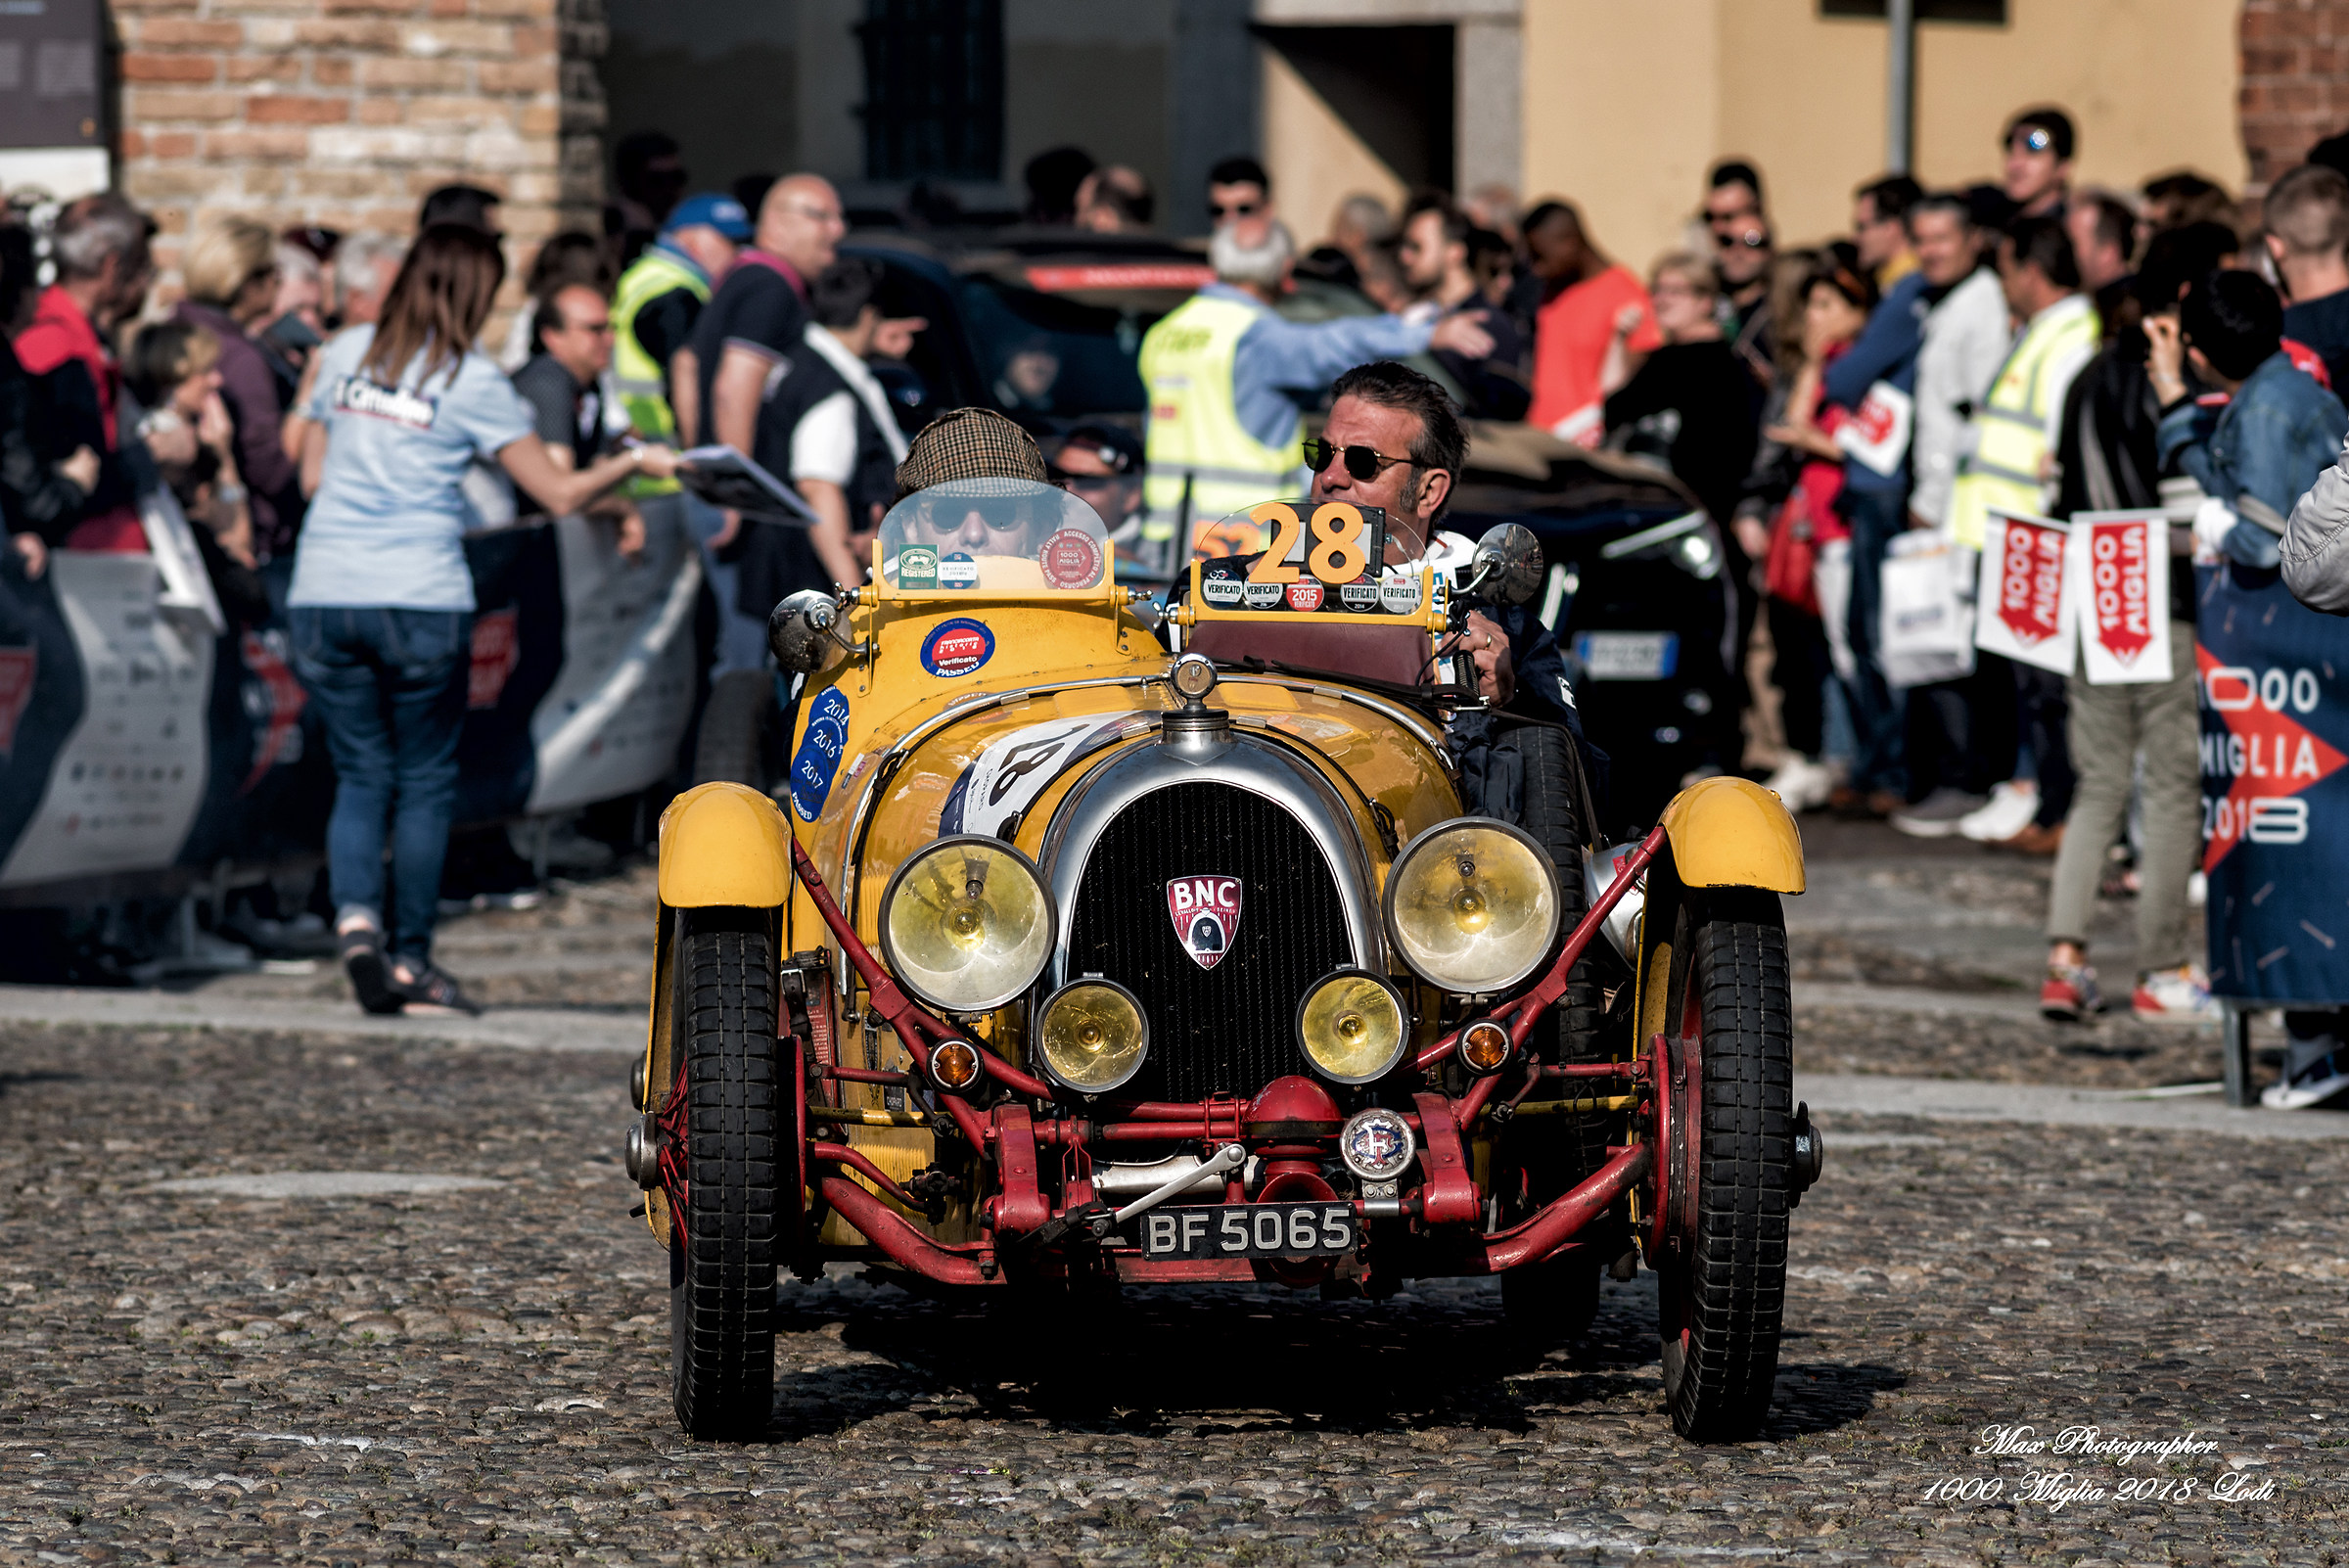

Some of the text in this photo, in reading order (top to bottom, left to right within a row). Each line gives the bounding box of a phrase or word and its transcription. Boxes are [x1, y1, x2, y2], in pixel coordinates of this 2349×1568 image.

[1248, 501, 1366, 584] 28
[2005, 528, 2034, 611] 1000
[2095, 533, 2122, 631] 1000
[2122, 527, 2146, 635] MIGLIA
[1207, 584, 1241, 595] VERIFICATO
[1246, 585, 1279, 595] VERIFICATO
[1292, 589, 1317, 601] 2015
[1343, 587, 1377, 599] VERIFICATO
[1382, 587, 1416, 599] VERIFICATO
[936, 662, 980, 677] PASSED
[939, 656, 978, 667] Verificato
[823, 698, 850, 726] 2014
[812, 729, 837, 759] 2016
[801, 760, 824, 789] 2017
[792, 791, 813, 820] PASSED
[2201, 795, 2309, 844] 2018
[1174, 880, 1236, 910] BNC
[1148, 1209, 1351, 1254] BF 5065
